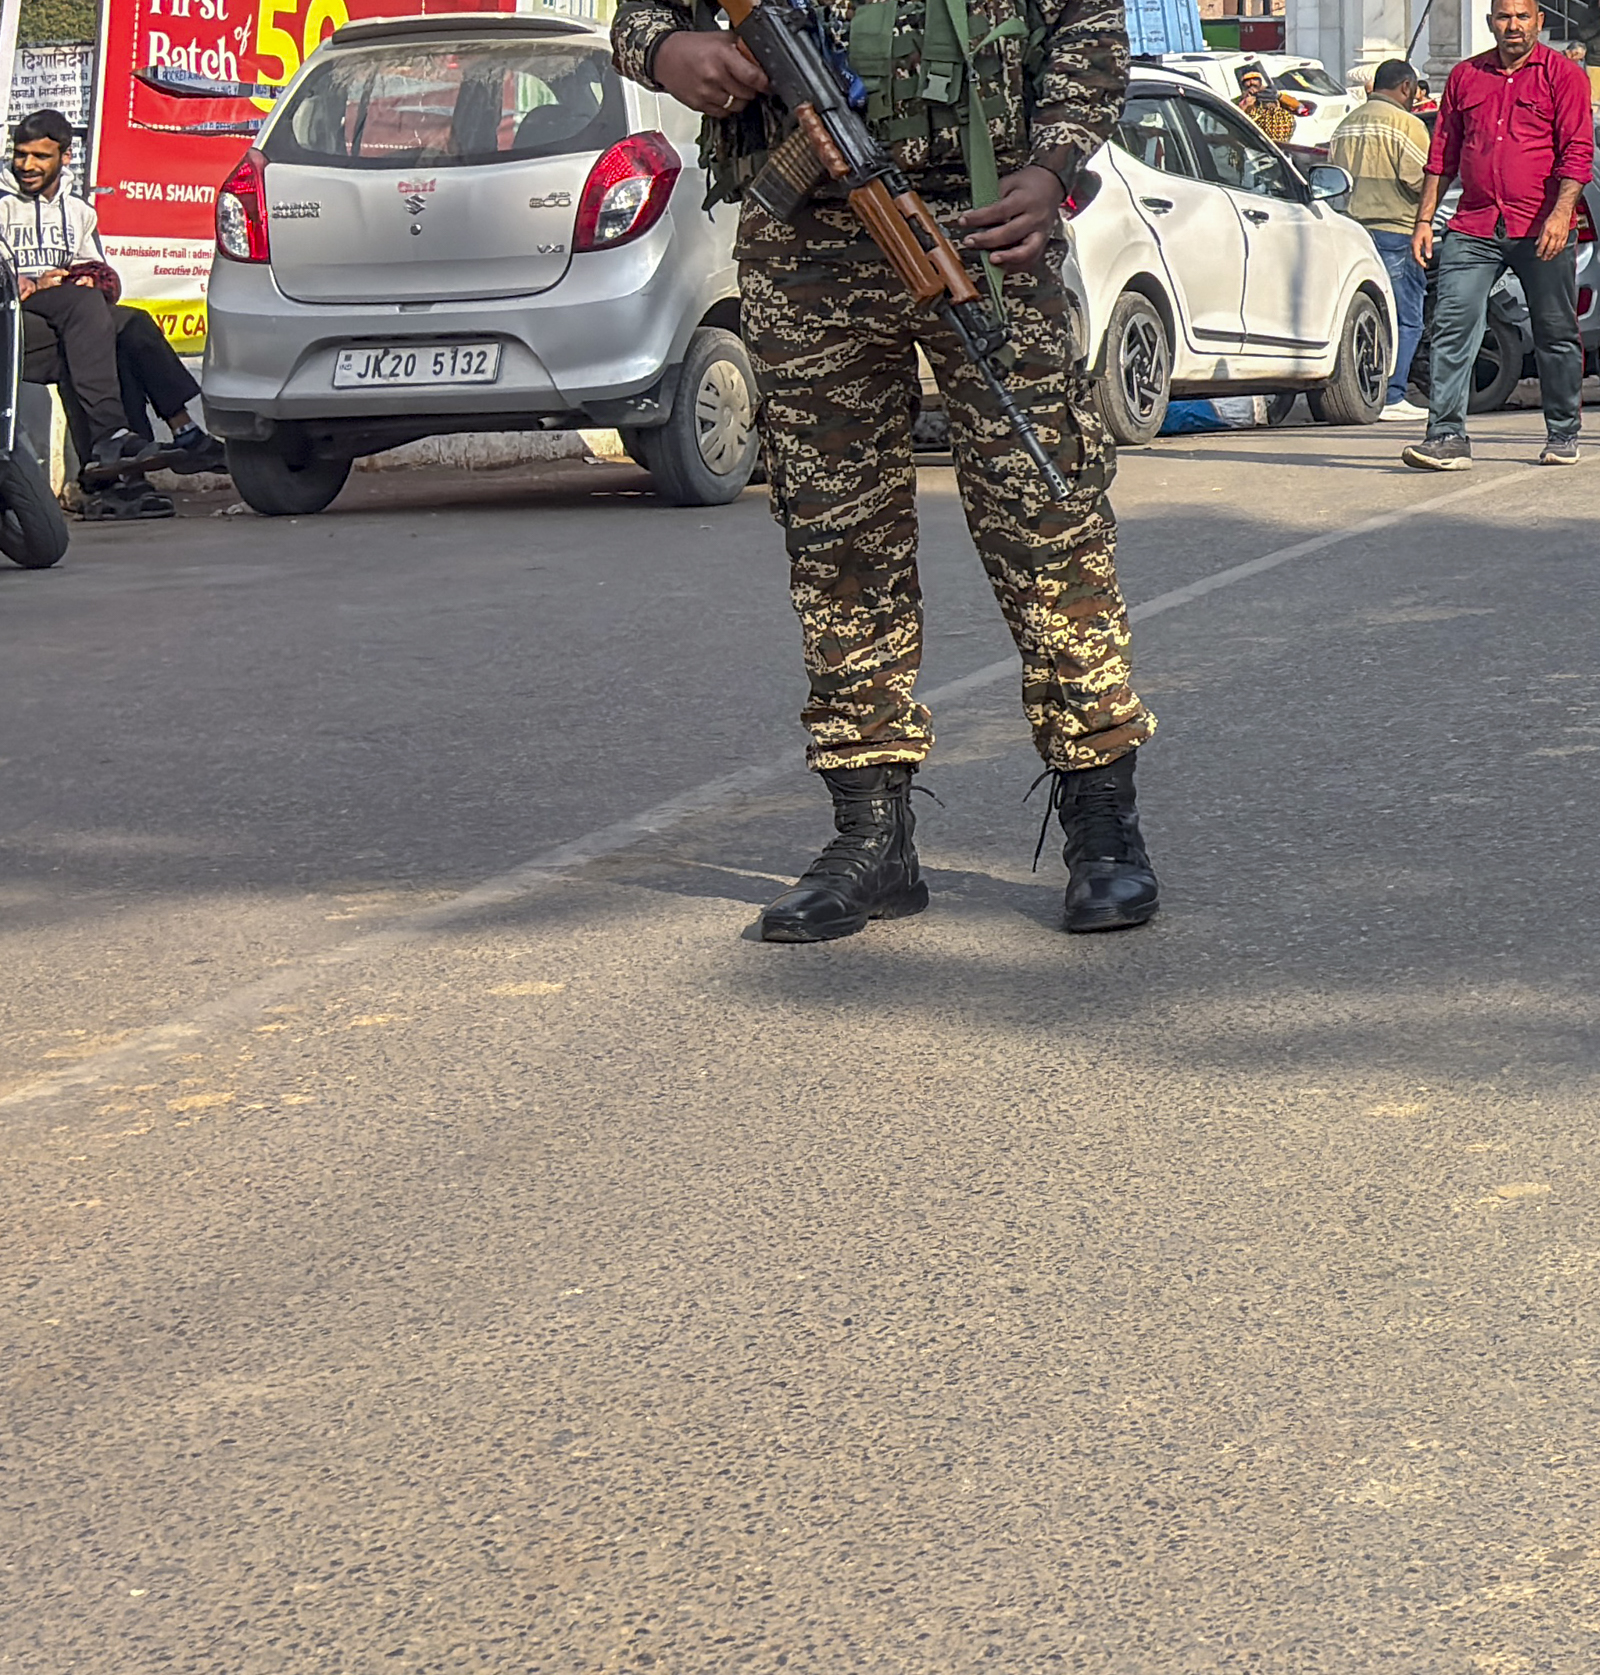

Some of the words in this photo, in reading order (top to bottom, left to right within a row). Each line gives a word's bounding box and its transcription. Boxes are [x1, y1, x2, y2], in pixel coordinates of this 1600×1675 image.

[233, 14, 253, 57] of
[148, 30, 241, 83] Batch
[166, 184, 215, 204] SHAKTI
[105, 245, 118, 256] For
[120, 246, 160, 258] Admission
[162, 247, 187, 259] E-mail
[153, 265, 191, 276] Executive
[357, 353, 417, 379] JK20
[432, 347, 488, 377] 5132
